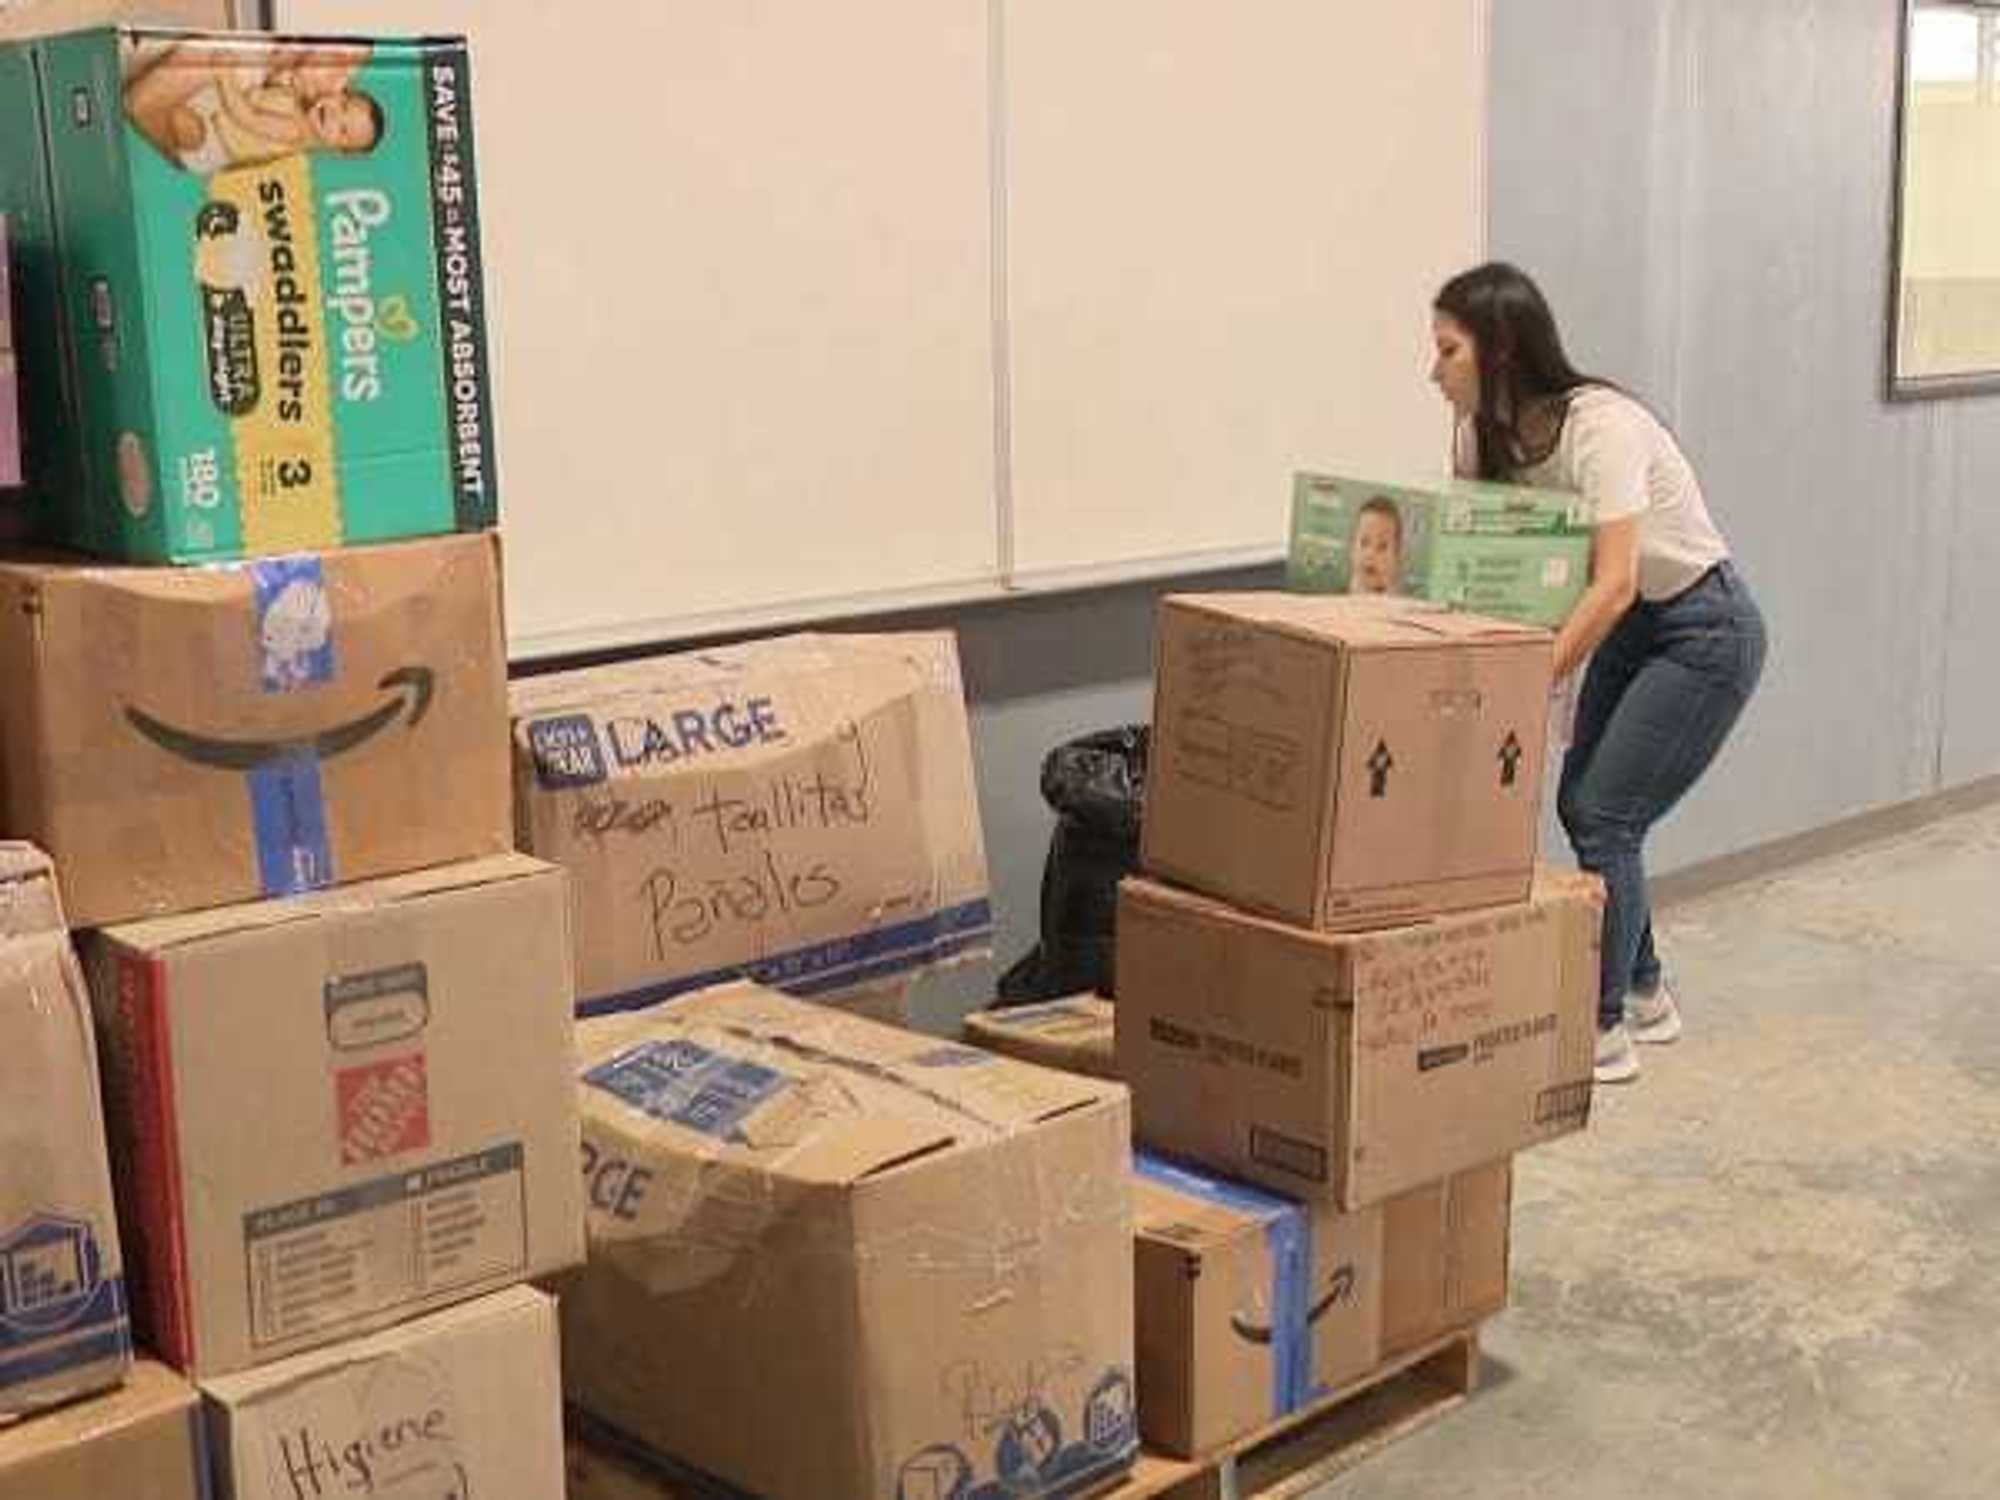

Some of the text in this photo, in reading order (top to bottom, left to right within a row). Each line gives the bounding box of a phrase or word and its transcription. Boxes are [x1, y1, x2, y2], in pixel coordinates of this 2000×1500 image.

[258, 178, 313, 423] swaddlers
[325, 187, 390, 403] Pampers
[442, 226, 471, 310] MOST
[450, 316, 485, 495] ABSORBENT
[279, 459, 313, 490] 3
[606, 697, 787, 768] LARGE
